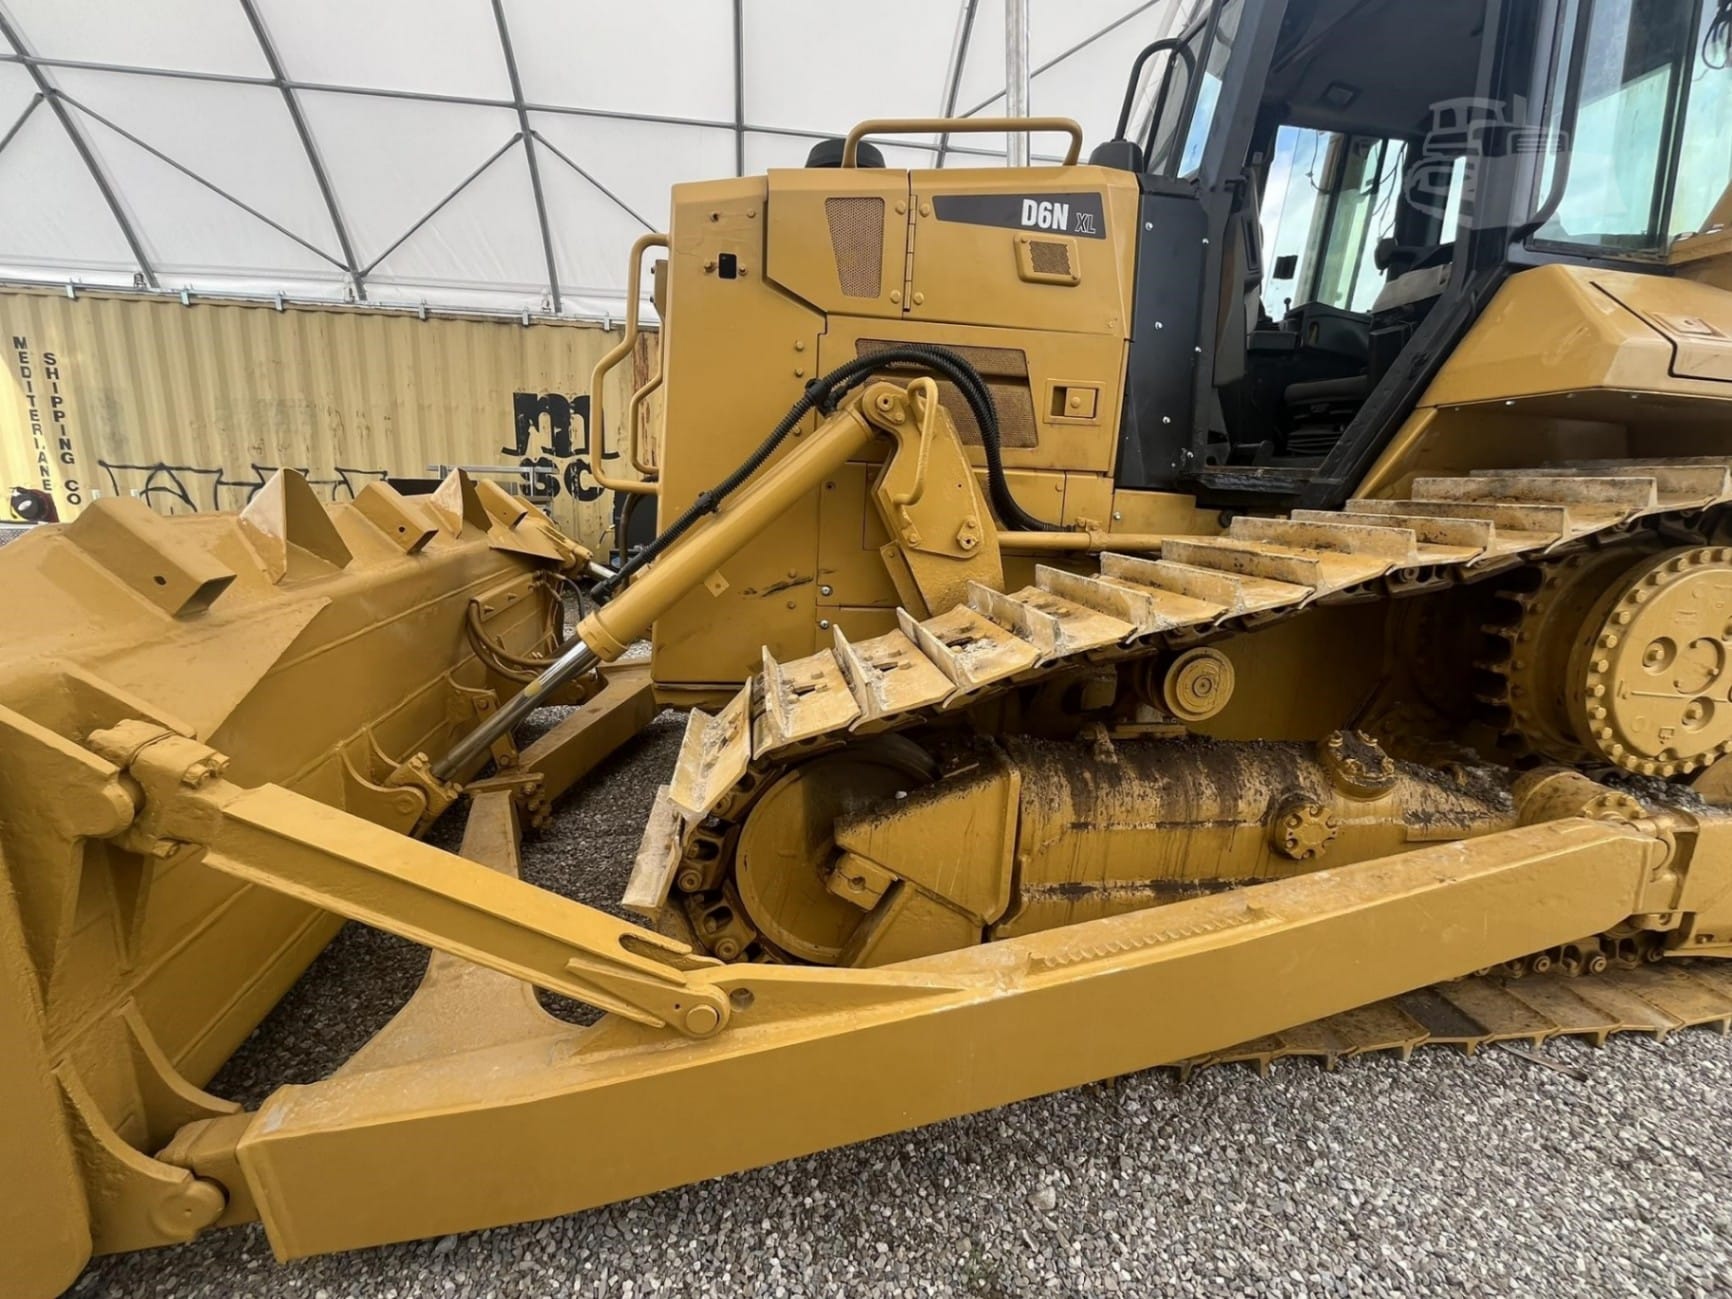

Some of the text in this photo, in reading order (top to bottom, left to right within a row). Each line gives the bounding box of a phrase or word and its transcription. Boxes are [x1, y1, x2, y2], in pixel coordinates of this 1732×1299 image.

[1021, 199, 1096, 234] D6N XL
[43, 352, 82, 505] SHIPPING CO
